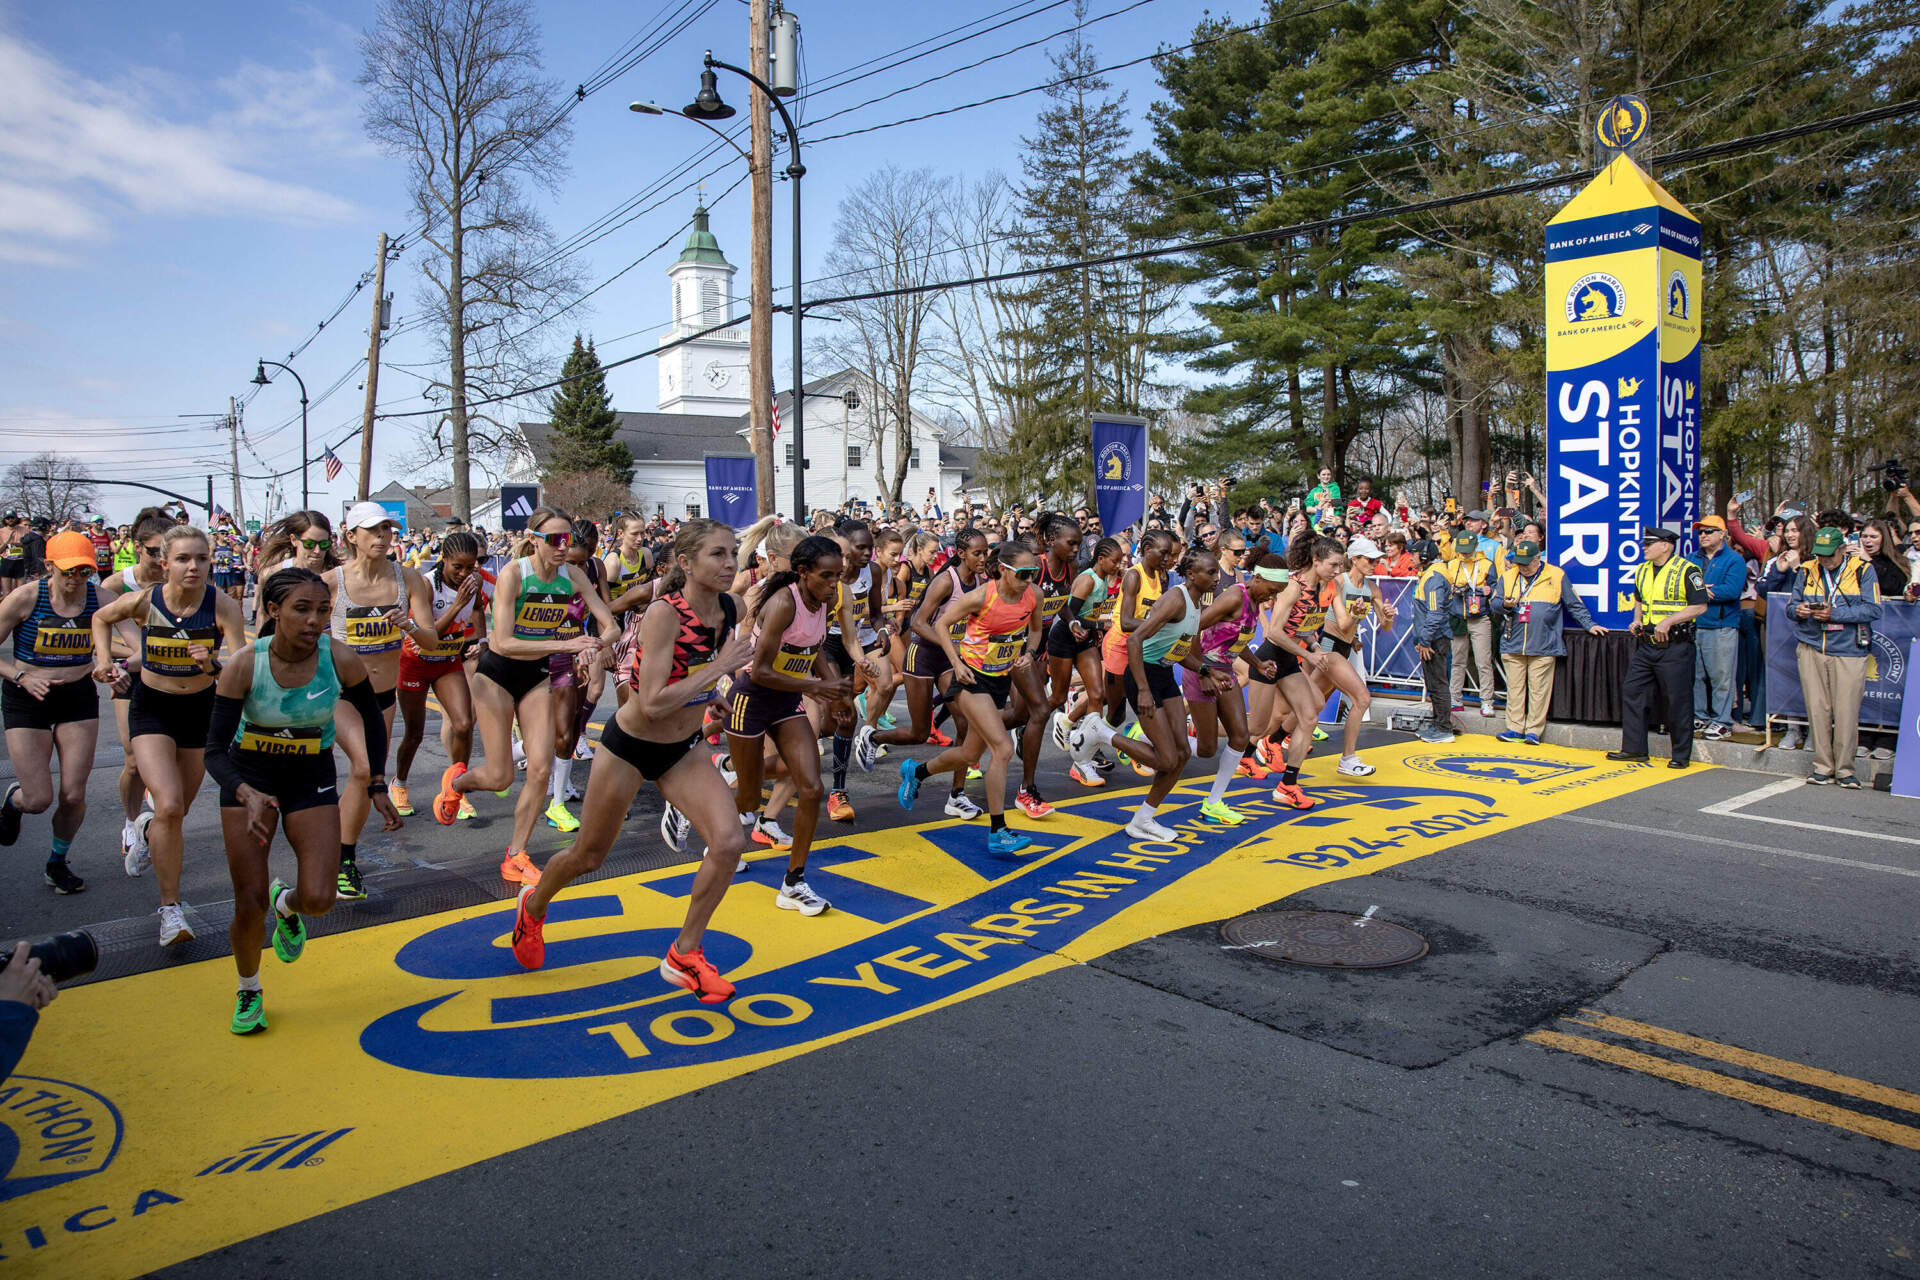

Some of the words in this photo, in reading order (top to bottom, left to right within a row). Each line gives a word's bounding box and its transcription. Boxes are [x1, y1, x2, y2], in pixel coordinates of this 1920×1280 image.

[1550, 239, 1574, 250] BANK
[1575, 237, 1588, 245] OF
[1589, 229, 1632, 244] AMERICA
[1660, 225, 1671, 236] BANK
[1676, 230, 1692, 245] AMERICA
[1570, 274, 1597, 298] BOSTON
[1600, 274, 1624, 311] MARATHON
[1557, 328, 1578, 337] BANK
[1591, 323, 1627, 333] AMERICA
[1662, 375, 1684, 556] STA
[1683, 407, 1695, 557] HOPKINTO
[1558, 379, 1610, 613] START
[1618, 404, 1641, 585] HOPKINTON
[522, 606, 565, 623] LENGER
[41, 632, 90, 649] LEMON
[997, 645, 1014, 659] DES
[783, 658, 811, 674] DIDA
[1863, 690, 1902, 700] MERICA
[1263, 808, 1509, 870] 1924-2024
[586, 992, 814, 1060] 100
[805, 897, 1085, 996] YEARS
[1040, 870, 1138, 899] IN
